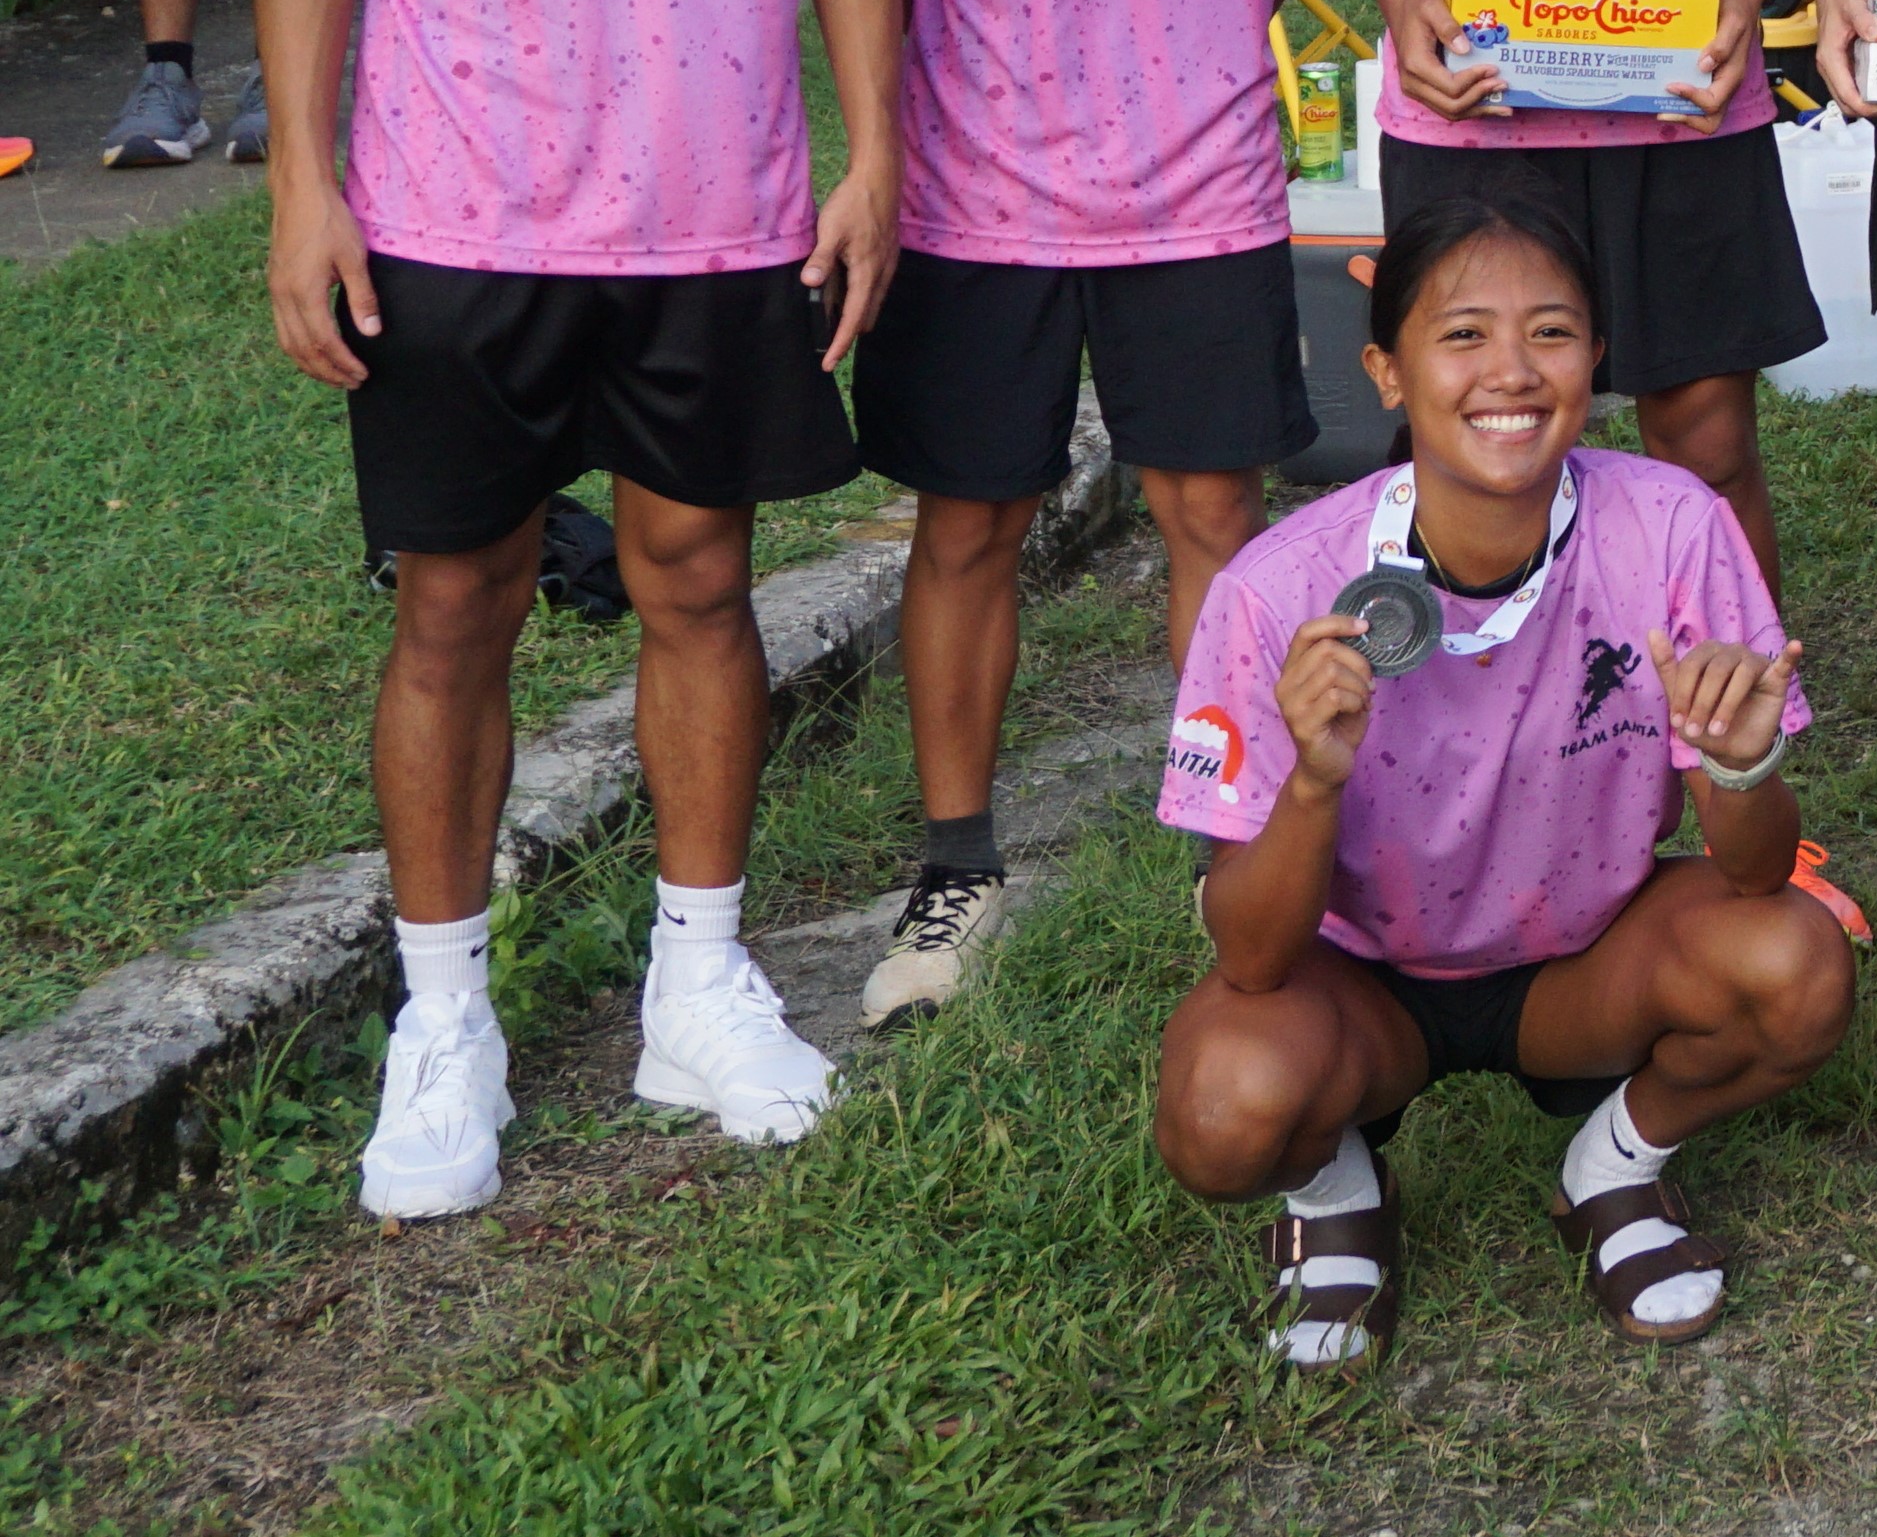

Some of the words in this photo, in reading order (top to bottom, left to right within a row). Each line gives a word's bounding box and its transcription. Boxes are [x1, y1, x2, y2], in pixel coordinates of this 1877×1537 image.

[1536, 28, 1598, 40] SABORES
[1499, 48, 1606, 67] BLUEBERRY
[1630, 54, 1674, 64] HIBISCUS
[1514, 65, 1565, 76] FLAVORED
[1566, 68, 1620, 79] SPARKLING
[1622, 70, 1656, 80] WATER
[1300, 106, 1338, 122] Chico
[1560, 731, 1608, 760] TEAM
[1612, 720, 1659, 738] SANTA
[1169, 747, 1222, 778] AITH
